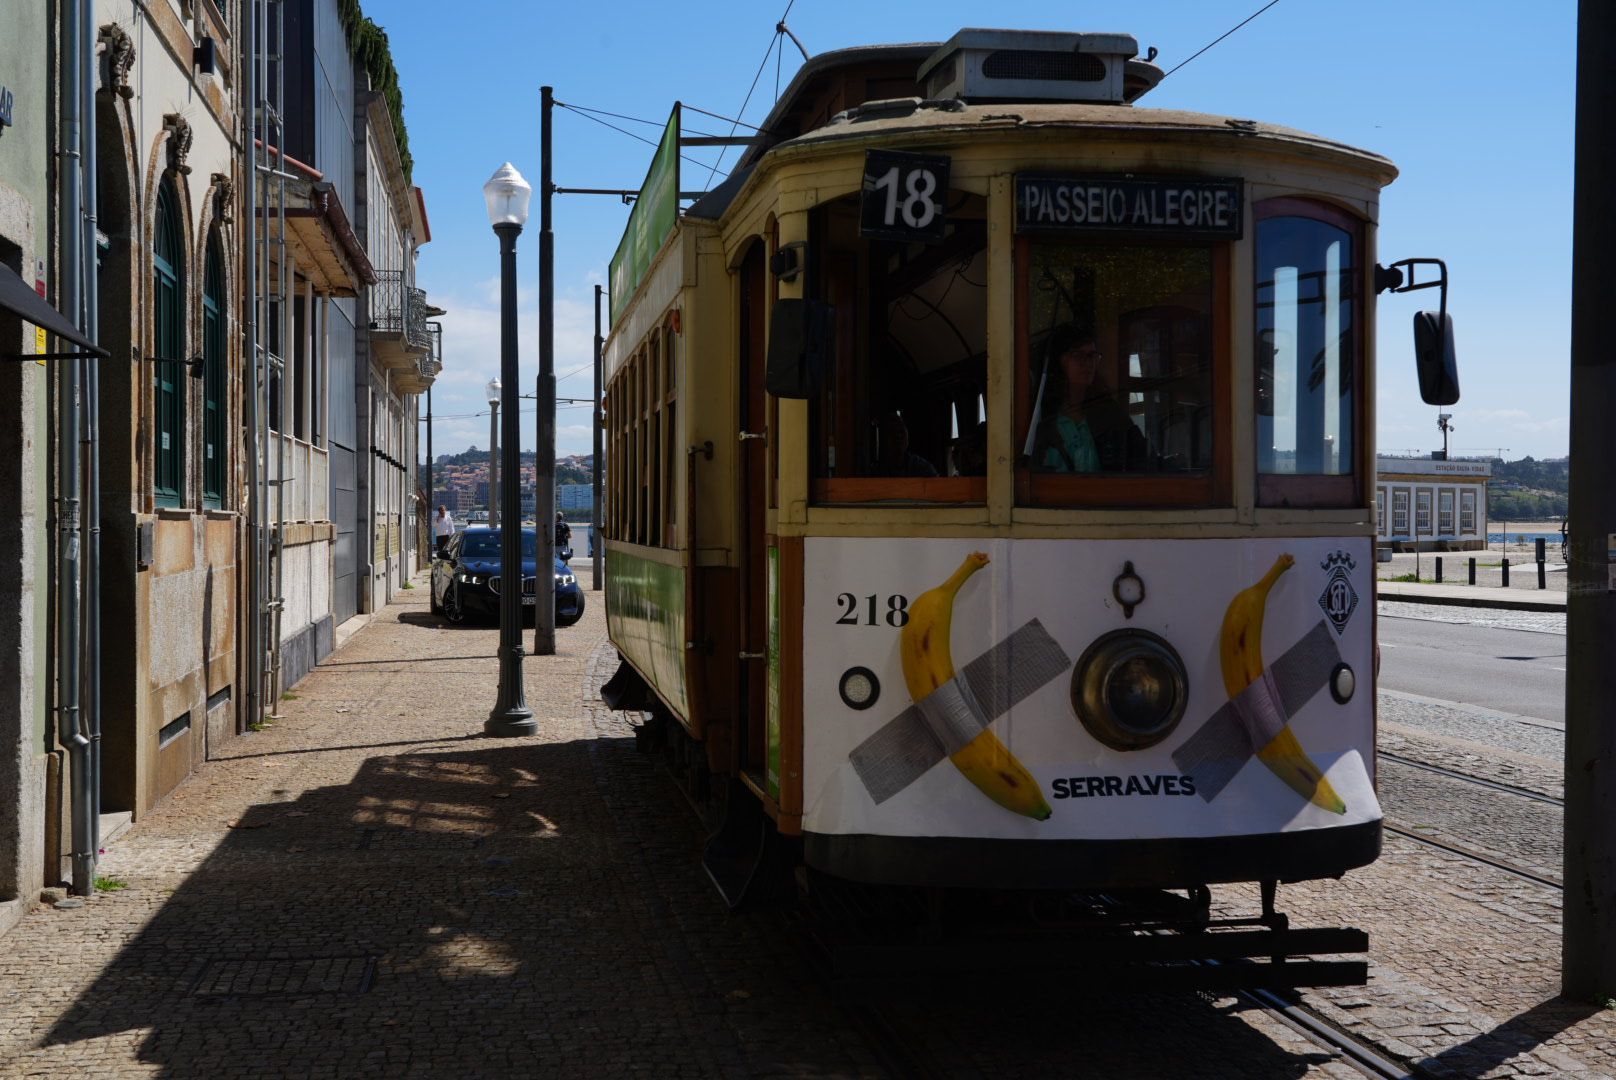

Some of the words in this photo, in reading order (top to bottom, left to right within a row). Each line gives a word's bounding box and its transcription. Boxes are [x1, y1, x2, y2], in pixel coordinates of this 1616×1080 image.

[875, 167, 937, 228] 18
[1024, 185, 1126, 224] PASSEIO
[1132, 189, 1229, 226] ALEGRE
[835, 592, 910, 628] 218
